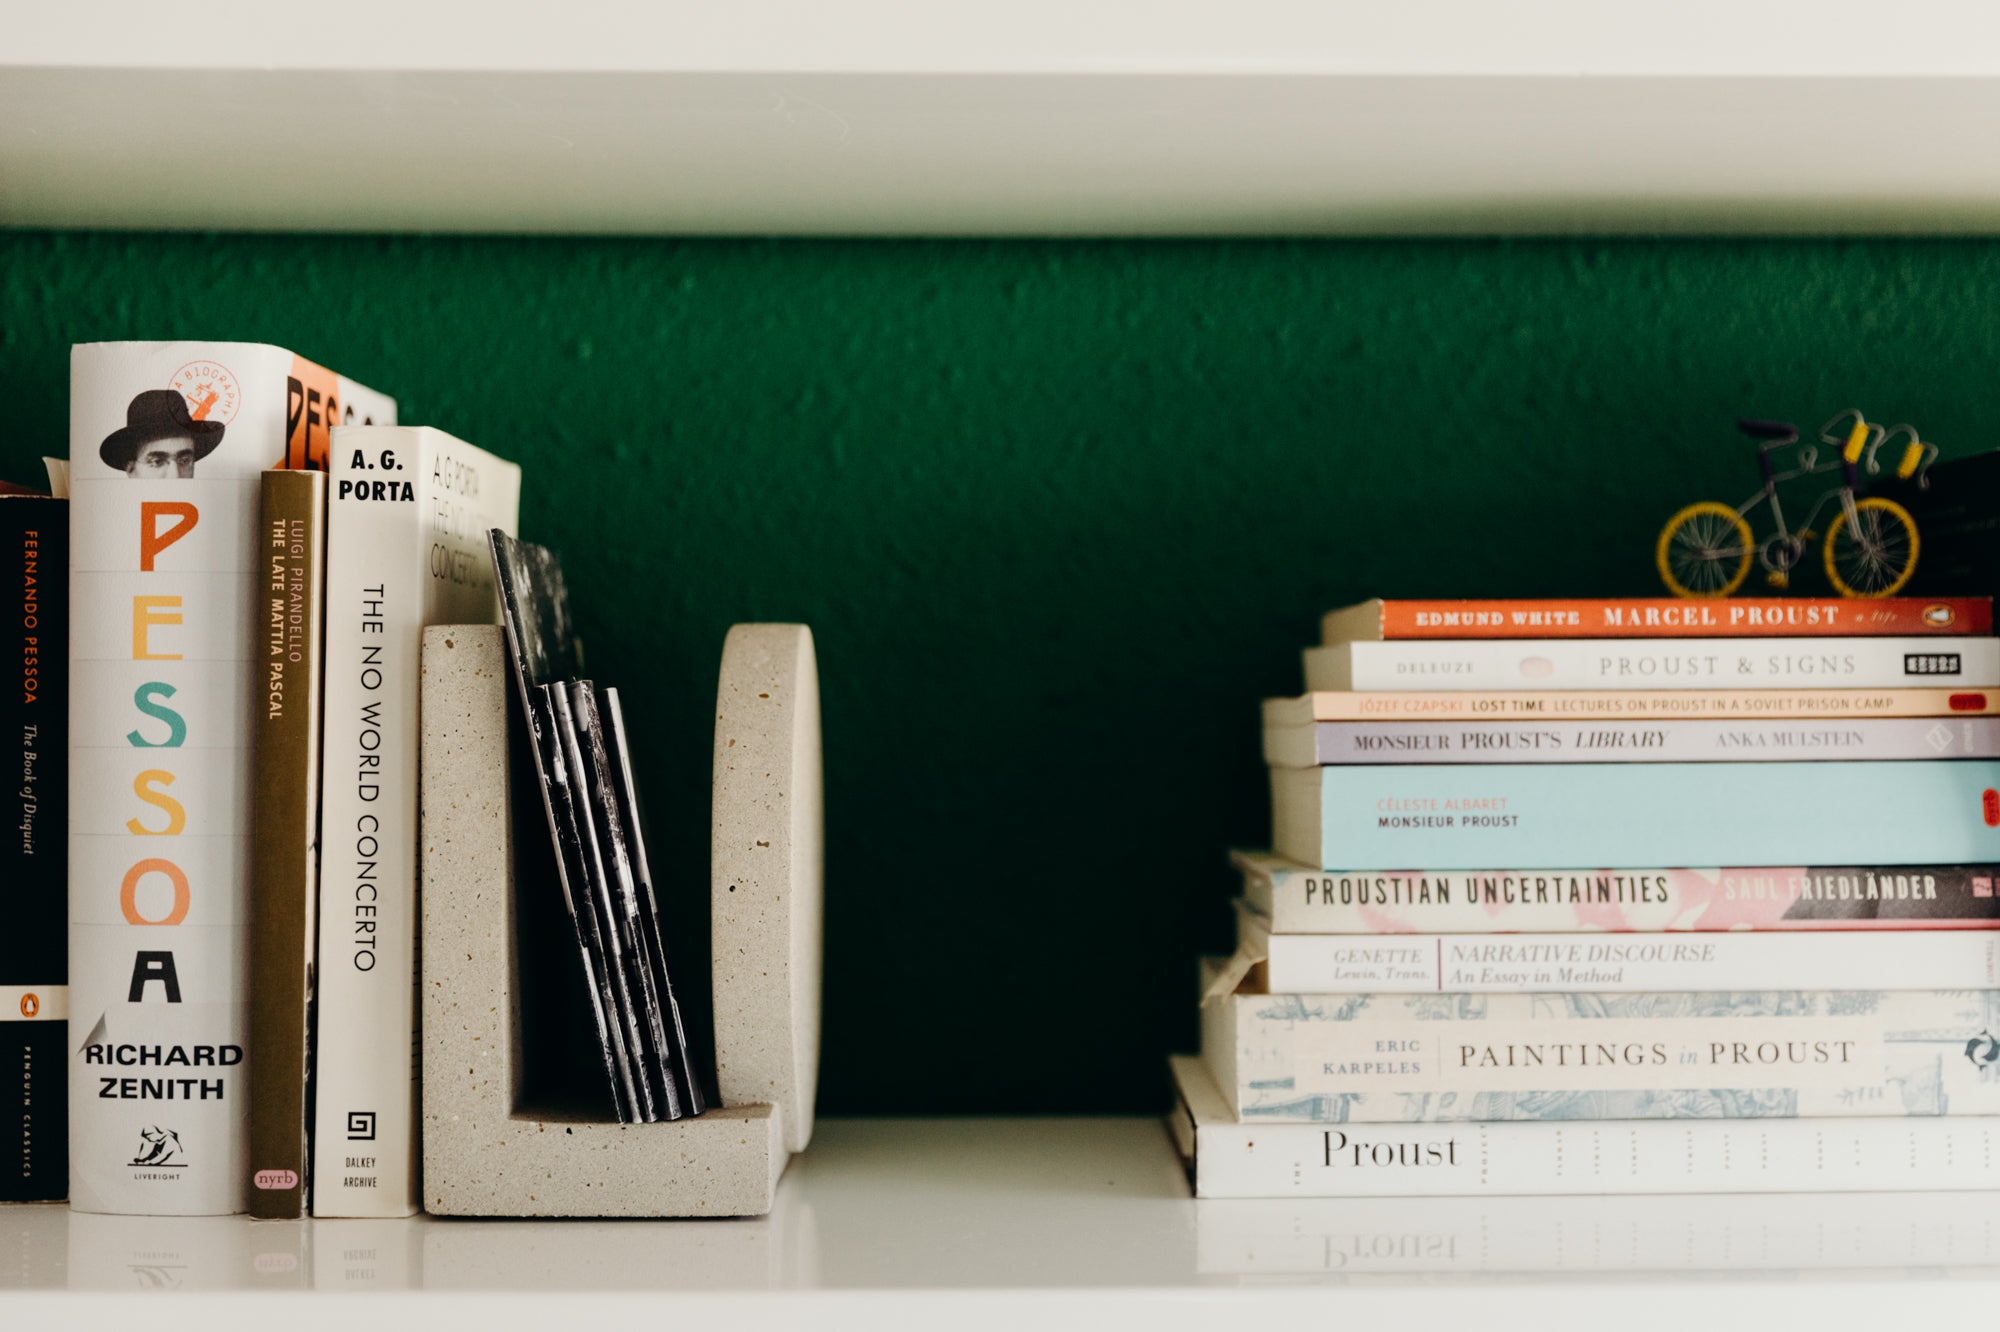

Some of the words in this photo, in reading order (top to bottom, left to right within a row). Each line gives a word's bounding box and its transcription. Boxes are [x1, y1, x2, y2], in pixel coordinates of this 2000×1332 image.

[339, 481, 414, 500] PORTA
[272, 519, 286, 550] THE
[291, 521, 304, 557] LUIGI
[24, 530, 37, 628] FERNANDO
[271, 556, 285, 591] LATE
[290, 569, 302, 663] PIRANDELLO
[362, 584, 384, 633] THE
[1416, 612, 1504, 626] EDMUND
[1511, 611, 1580, 625] WHITE
[1604, 607, 1717, 626] MARCEL
[1729, 606, 1840, 625] PROUST
[270, 598, 284, 655] MATTIA
[24, 637, 37, 704] PESSOA
[361, 646, 382, 690] NO
[1396, 662, 1475, 675] DELEUZE
[1599, 656, 1720, 676] PROUST
[1737, 657, 1754, 674] &
[1768, 655, 1857, 675] SIGNS
[269, 662, 282, 720] PASCAL
[1404, 699, 1463, 712] CZAPSKI
[1472, 700, 1506, 712] LOST
[1512, 700, 1545, 712] TIME
[1553, 699, 1624, 712] LECTURES
[1627, 699, 1648, 712] ON
[1653, 699, 1708, 711] PROUST
[1712, 699, 1728, 711] IN
[1731, 699, 1739, 711] A
[1744, 699, 1795, 711] SOVIET
[1799, 698, 1850, 710] PRISON
[1855, 697, 1894, 709] CAMP
[24, 725, 38, 746] The
[1354, 735, 1450, 750] MONSIEUR
[1461, 732, 1563, 749] PROUST'S
[1575, 731, 1670, 748] LIBRARY
[1716, 733, 1767, 747] ANKA
[119, 502, 200, 1003] PESSOA
[358, 702, 381, 802] WORLD
[23, 752, 37, 783] Book
[18, 786, 36, 801] of
[1377, 797, 1438, 812] CÉLESTE
[1444, 798, 1508, 811] ALBARET
[17, 804, 36, 854] Disquiet
[1378, 816, 1454, 828] MONSIEUR
[1462, 815, 1519, 828] PROUST
[354, 815, 379, 972] CONCERTO
[1305, 878, 1450, 904] PROUSTIAN
[1466, 876, 1669, 903] UNCERTAINTIES
[1725, 876, 1777, 899] SAUL
[1788, 872, 1937, 900] FRIEDLÄNDER
[1334, 948, 1423, 963] GENETTE
[1450, 944, 1582, 962] NARRATIVE
[1587, 943, 1716, 962] DISCOURSE
[1449, 969, 1475, 984] An
[1480, 968, 1530, 987] Essay
[1534, 969, 1551, 983] in
[1556, 967, 1624, 984] Method
[86, 1044, 244, 1067] RICHARD
[1375, 1040, 1421, 1052] ERIC
[1459, 1043, 1668, 1067] PAINTINGS
[1679, 1048, 1698, 1065] in
[1710, 1041, 1856, 1064] PROUST
[23, 1046, 31, 1106] PENGUIN
[1323, 1062, 1422, 1075] KARPELES
[99, 1078, 224, 1100] ZENITH
[23, 1114, 31, 1177] CLASSICS
[1320, 1130, 1463, 1167] Proust
[345, 1157, 376, 1168] DALKEY
[134, 1173, 180, 1181] LIVERIGHT
[258, 1173, 294, 1188] nyrb
[343, 1177, 377, 1188] ARCHIVE
